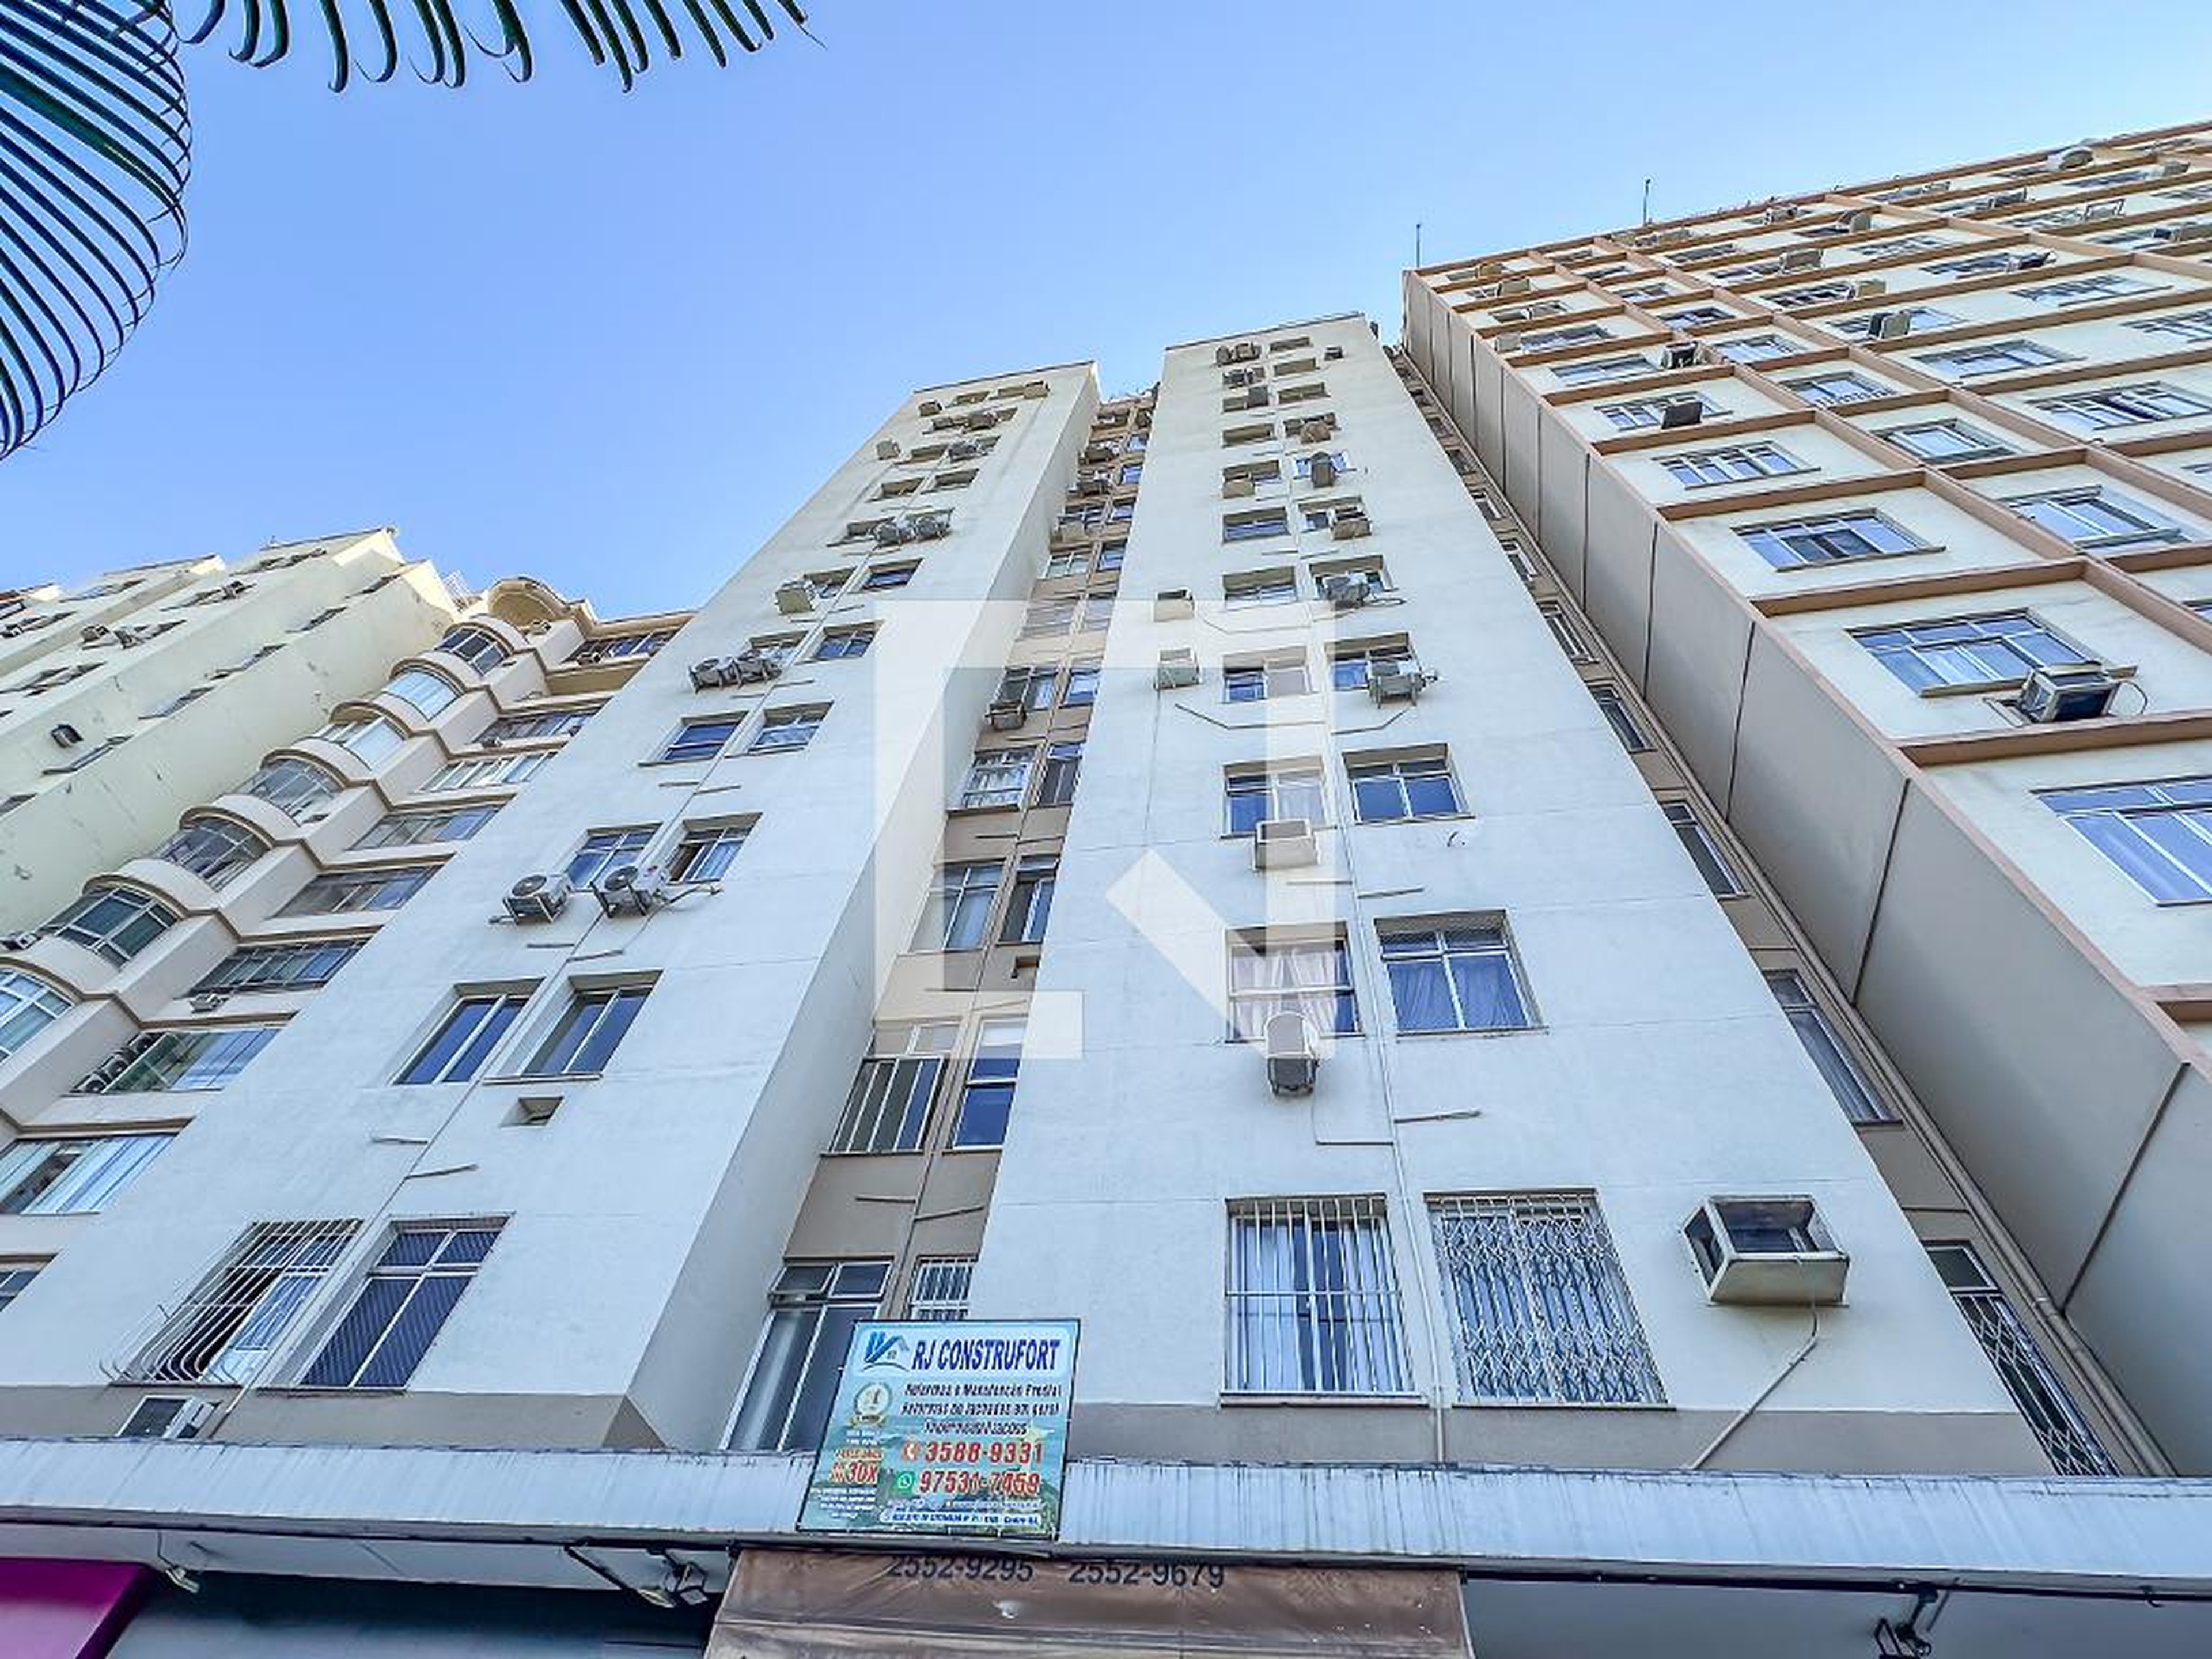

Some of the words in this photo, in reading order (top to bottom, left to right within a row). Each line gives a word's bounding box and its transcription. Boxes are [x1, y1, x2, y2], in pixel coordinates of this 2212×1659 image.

[911, 1339, 936, 1370] RJ
[937, 1339, 1061, 1370] CONSTRUFORT
[925, 1441, 1042, 1464] 3588-9331
[1069, 1560, 1225, 1588] 2552-9679
